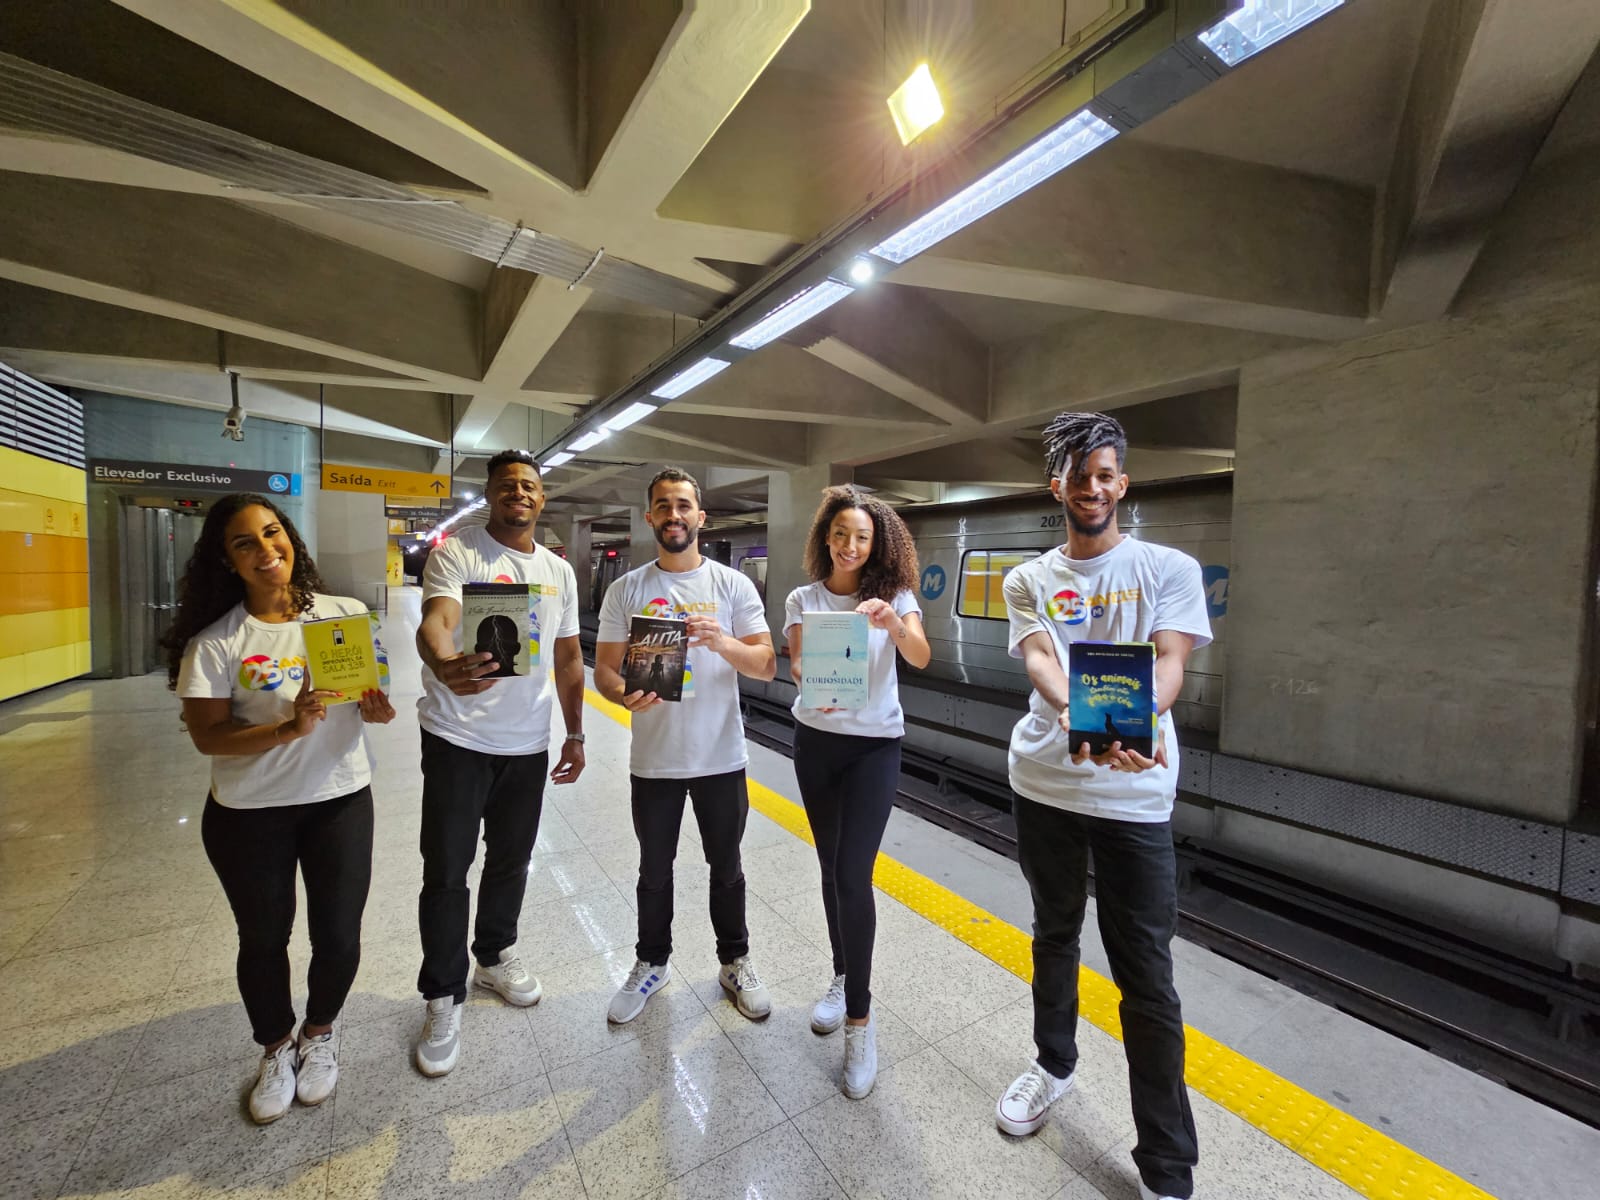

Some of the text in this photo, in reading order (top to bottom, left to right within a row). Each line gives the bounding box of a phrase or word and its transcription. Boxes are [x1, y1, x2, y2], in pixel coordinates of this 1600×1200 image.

[94, 466, 232, 485] Elevador Exclusivo
[329, 472, 396, 489] Saída Exit
[1040, 514, 1066, 528] 207
[922, 573, 944, 592] M
[1051, 594, 1087, 622] 25
[243, 656, 307, 690] 25 AN
[806, 677, 863, 685] CURIOSIDADE
